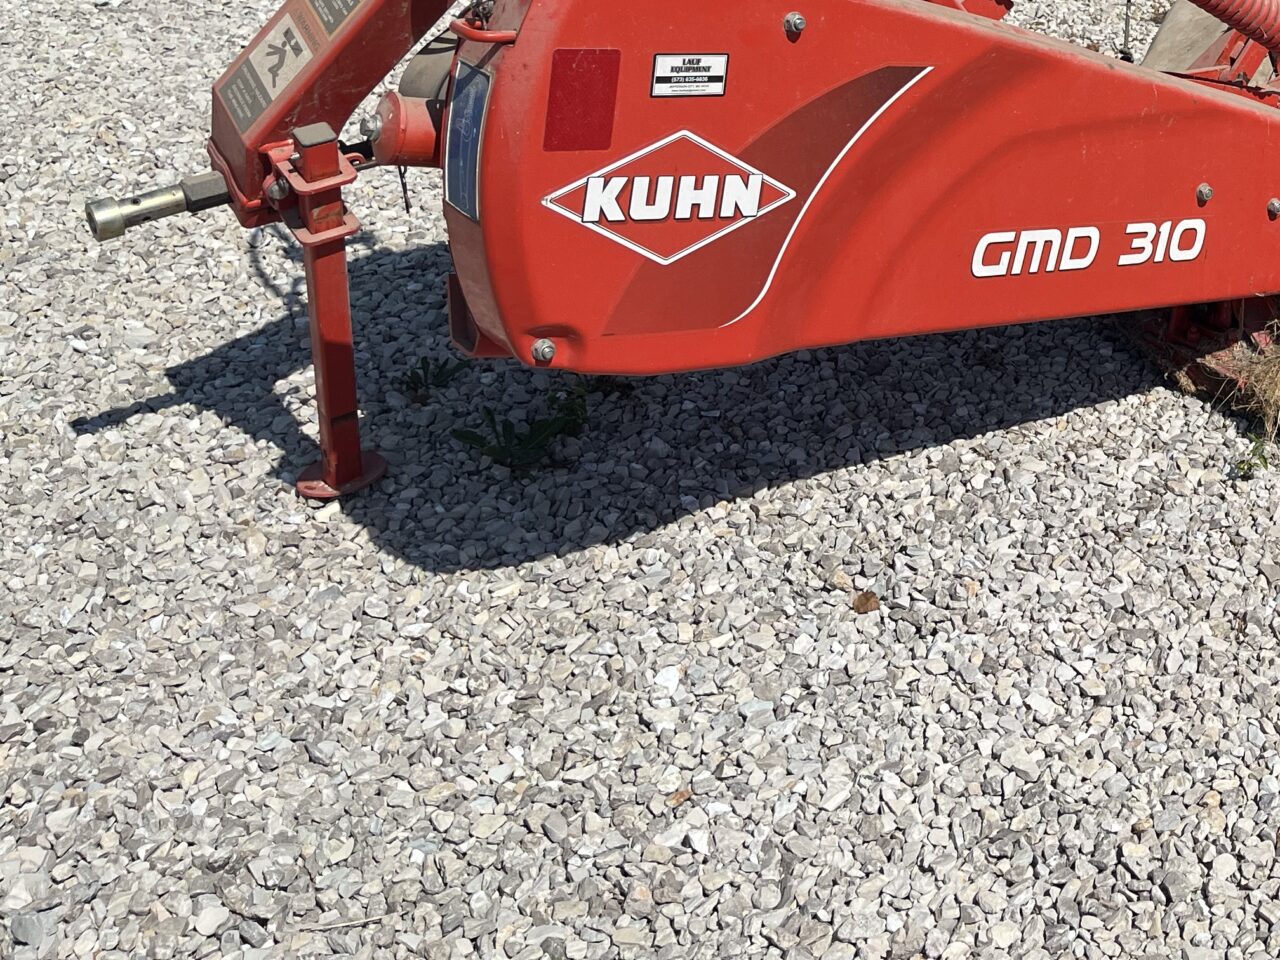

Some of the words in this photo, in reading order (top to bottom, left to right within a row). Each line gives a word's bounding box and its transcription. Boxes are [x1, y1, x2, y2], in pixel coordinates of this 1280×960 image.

[670, 66, 712, 74] EQUIPMENT
[582, 173, 764, 223] KUHN
[971, 224, 1100, 278] GMD
[1117, 218, 1207, 266] 310
